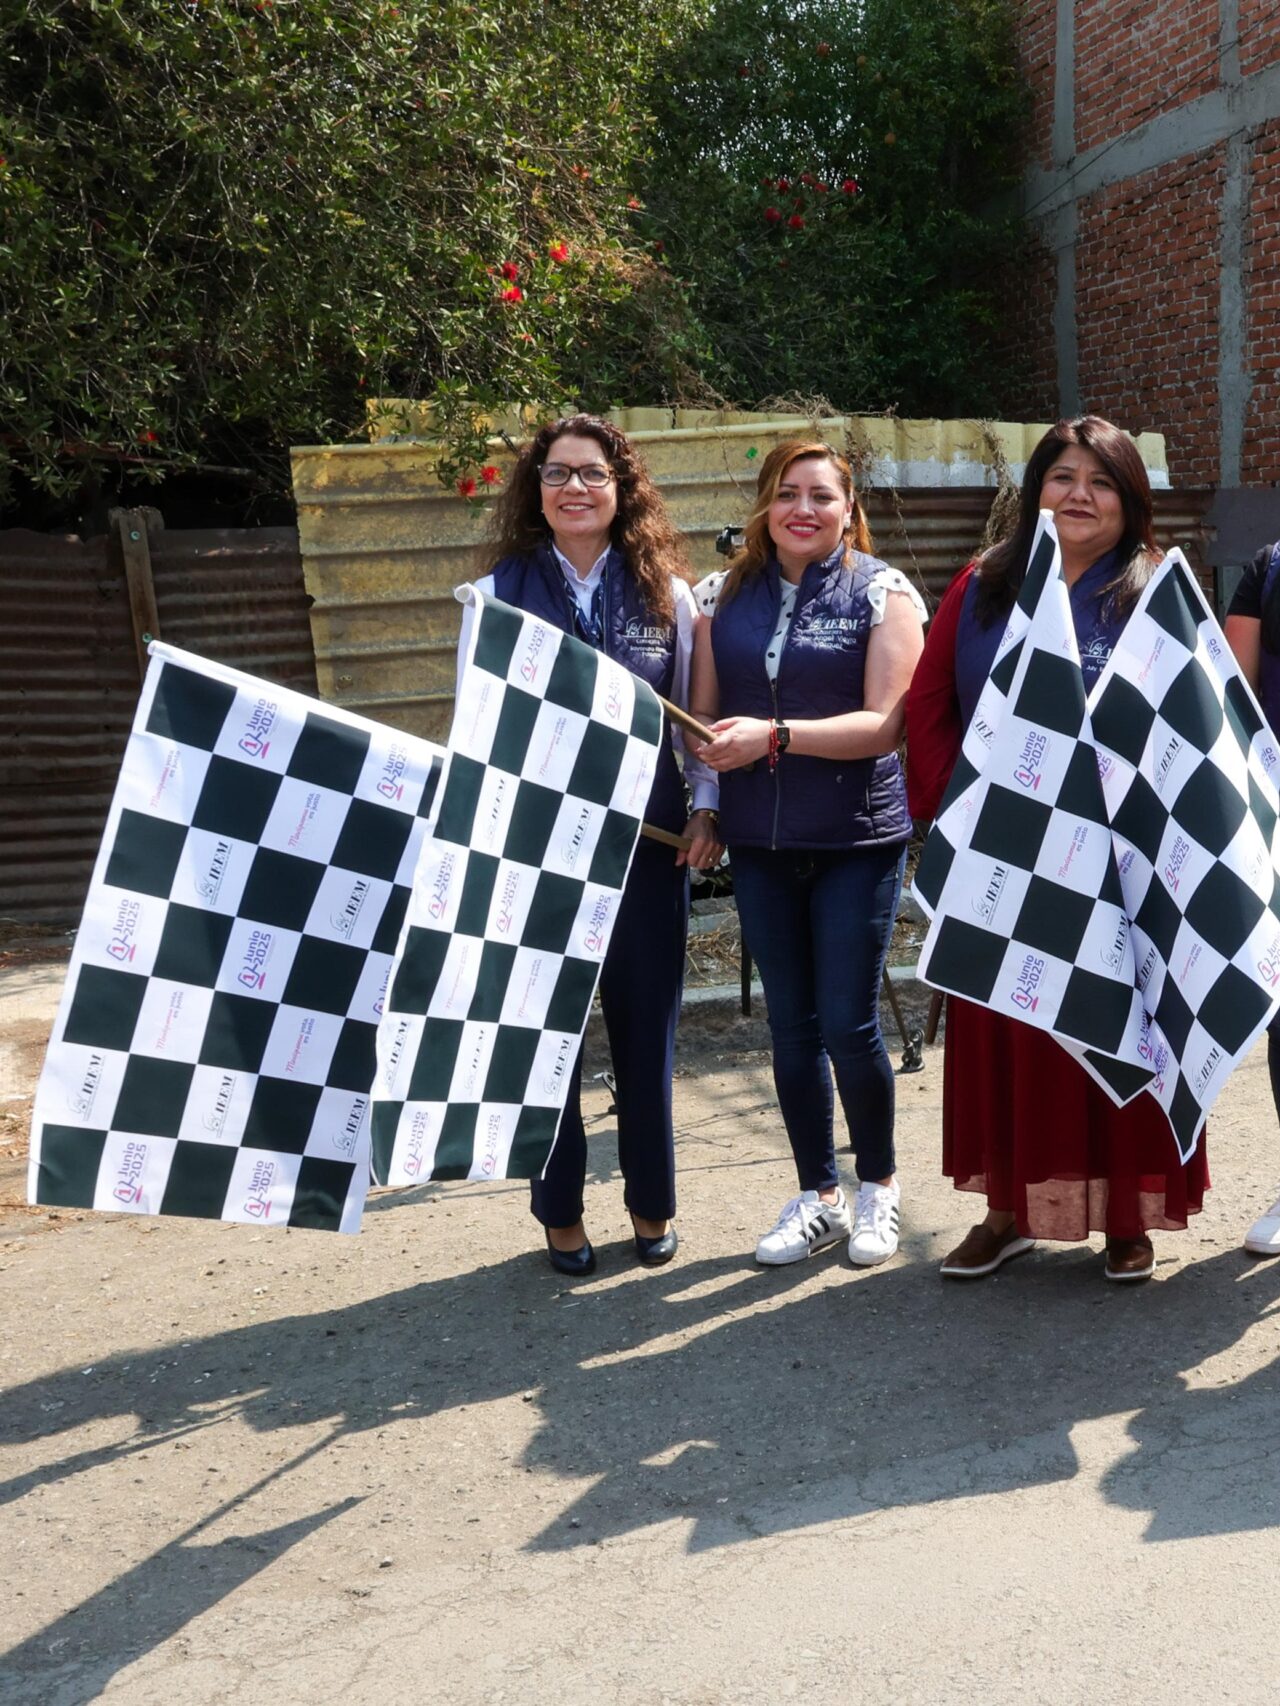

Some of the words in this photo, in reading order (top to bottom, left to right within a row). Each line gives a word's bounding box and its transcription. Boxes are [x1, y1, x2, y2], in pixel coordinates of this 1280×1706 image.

[246, 698, 266, 731] Junio
[258, 702, 278, 736] 2025
[1019, 731, 1037, 762] Junio
[1029, 735, 1047, 766] 2025
[1160, 737, 1180, 773] IEEM
[209, 841, 229, 880] IEEM
[1169, 835, 1183, 863] Junio
[1176, 842, 1190, 871] 2025
[345, 880, 367, 917] IEEM
[986, 865, 1006, 902] IEEM
[112, 899, 129, 933] Junio
[124, 901, 141, 937] 2025
[244, 930, 261, 963] Junio
[255, 933, 272, 966] 2025
[1015, 954, 1035, 985] Junio
[1027, 958, 1045, 990] 2025
[82, 1054, 102, 1095] IEEM
[553, 1039, 570, 1077] IEEM
[1201, 1047, 1219, 1078] IEEM
[215, 1075, 233, 1114] IEEM
[346, 1098, 365, 1134] IEEM
[119, 1142, 135, 1177] Junio
[131, 1144, 147, 1178] 2025
[248, 1160, 264, 1192] Junio
[259, 1162, 275, 1193] 2025
